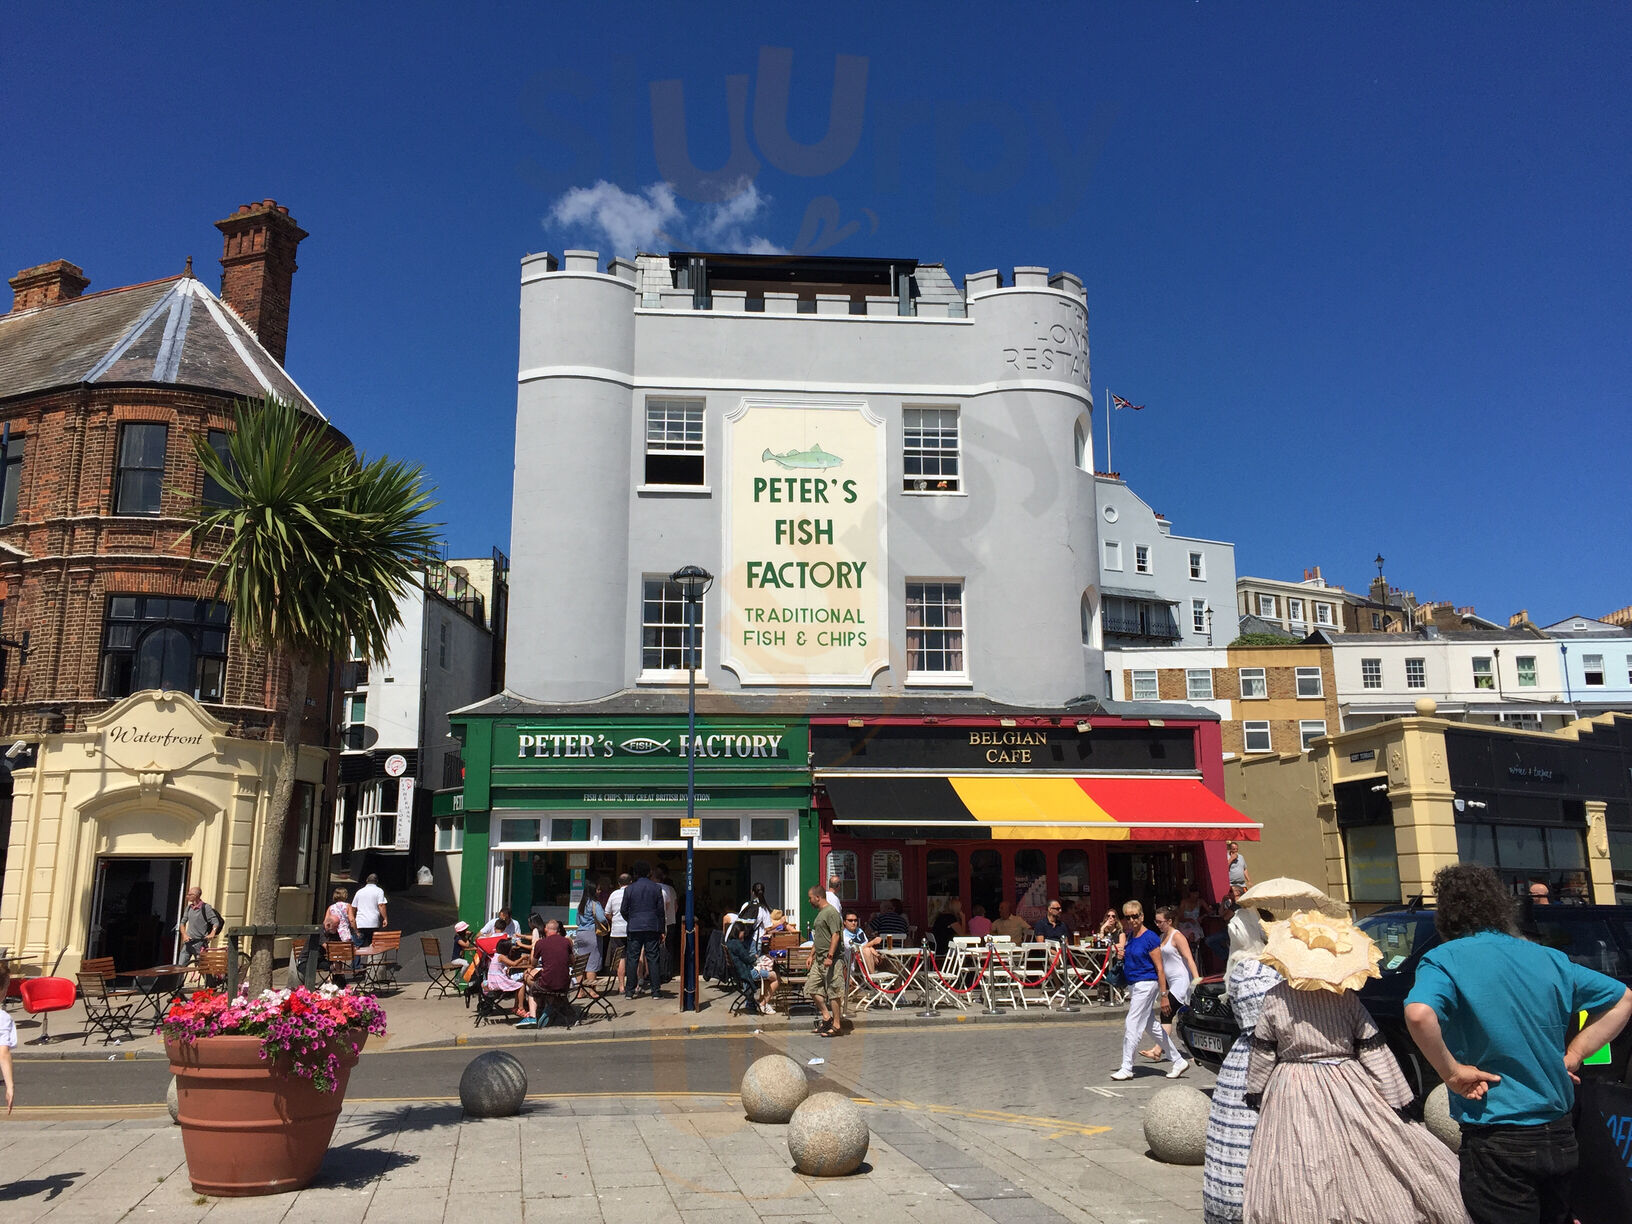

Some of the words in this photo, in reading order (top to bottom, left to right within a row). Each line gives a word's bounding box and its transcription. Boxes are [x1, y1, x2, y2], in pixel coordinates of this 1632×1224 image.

[753, 477, 858, 504] PETER'S
[775, 519, 834, 545] FISH
[746, 561, 867, 589] FACTORY
[744, 607, 865, 624] TRADITIONAL
[743, 630, 785, 646] FISH
[796, 631, 807, 646] &
[817, 631, 867, 647] CHIPS
[110, 725, 203, 746] Waterfront
[969, 731, 1047, 745] BELGIAN
[629, 742, 652, 750] FISH
[678, 734, 782, 758] FACTORY
[986, 749, 1032, 763] CAFE
[583, 793, 597, 801] FISH
[598, 793, 603, 801] &
[624, 793, 635, 801] THE
[636, 793, 654, 801] GREAT
[655, 793, 679, 801] BRITISH
[680, 793, 710, 801] INVNTION
